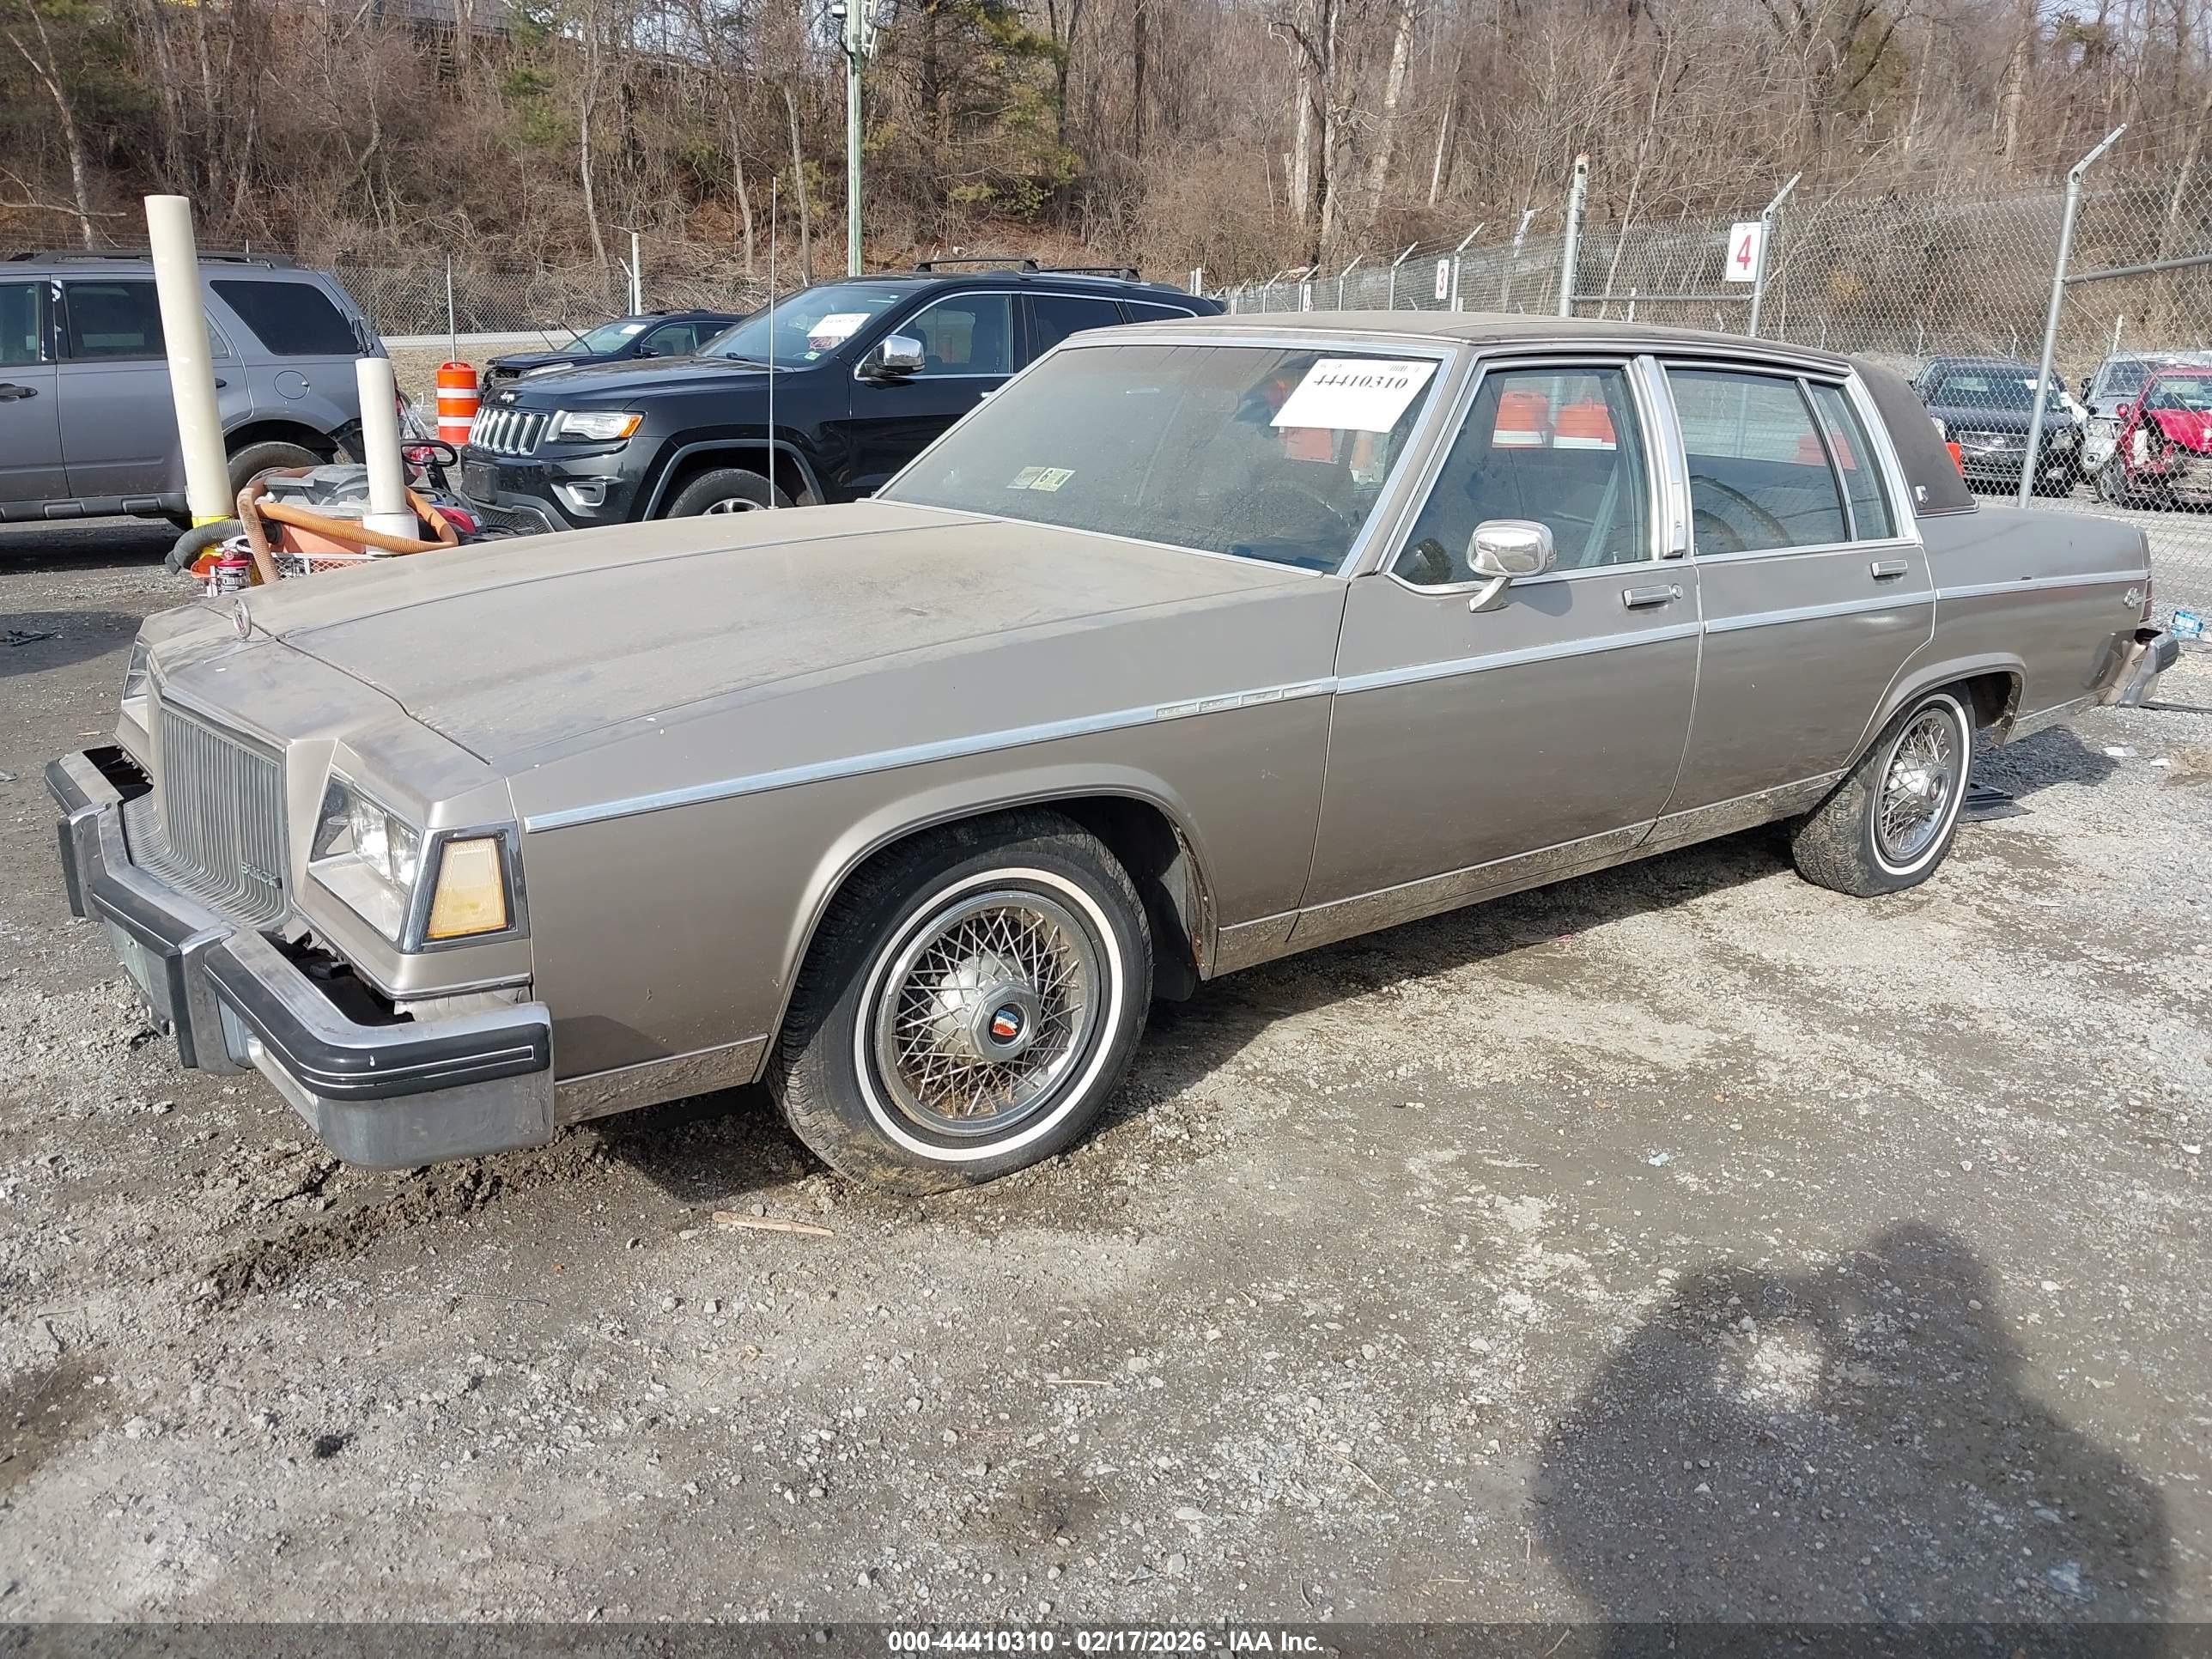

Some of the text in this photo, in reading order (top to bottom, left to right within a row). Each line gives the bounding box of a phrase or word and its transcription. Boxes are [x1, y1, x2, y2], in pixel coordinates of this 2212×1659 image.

[1736, 234, 1752, 270] 4
[1439, 267, 1445, 292] 3
[1314, 374, 1408, 389] 44410310
